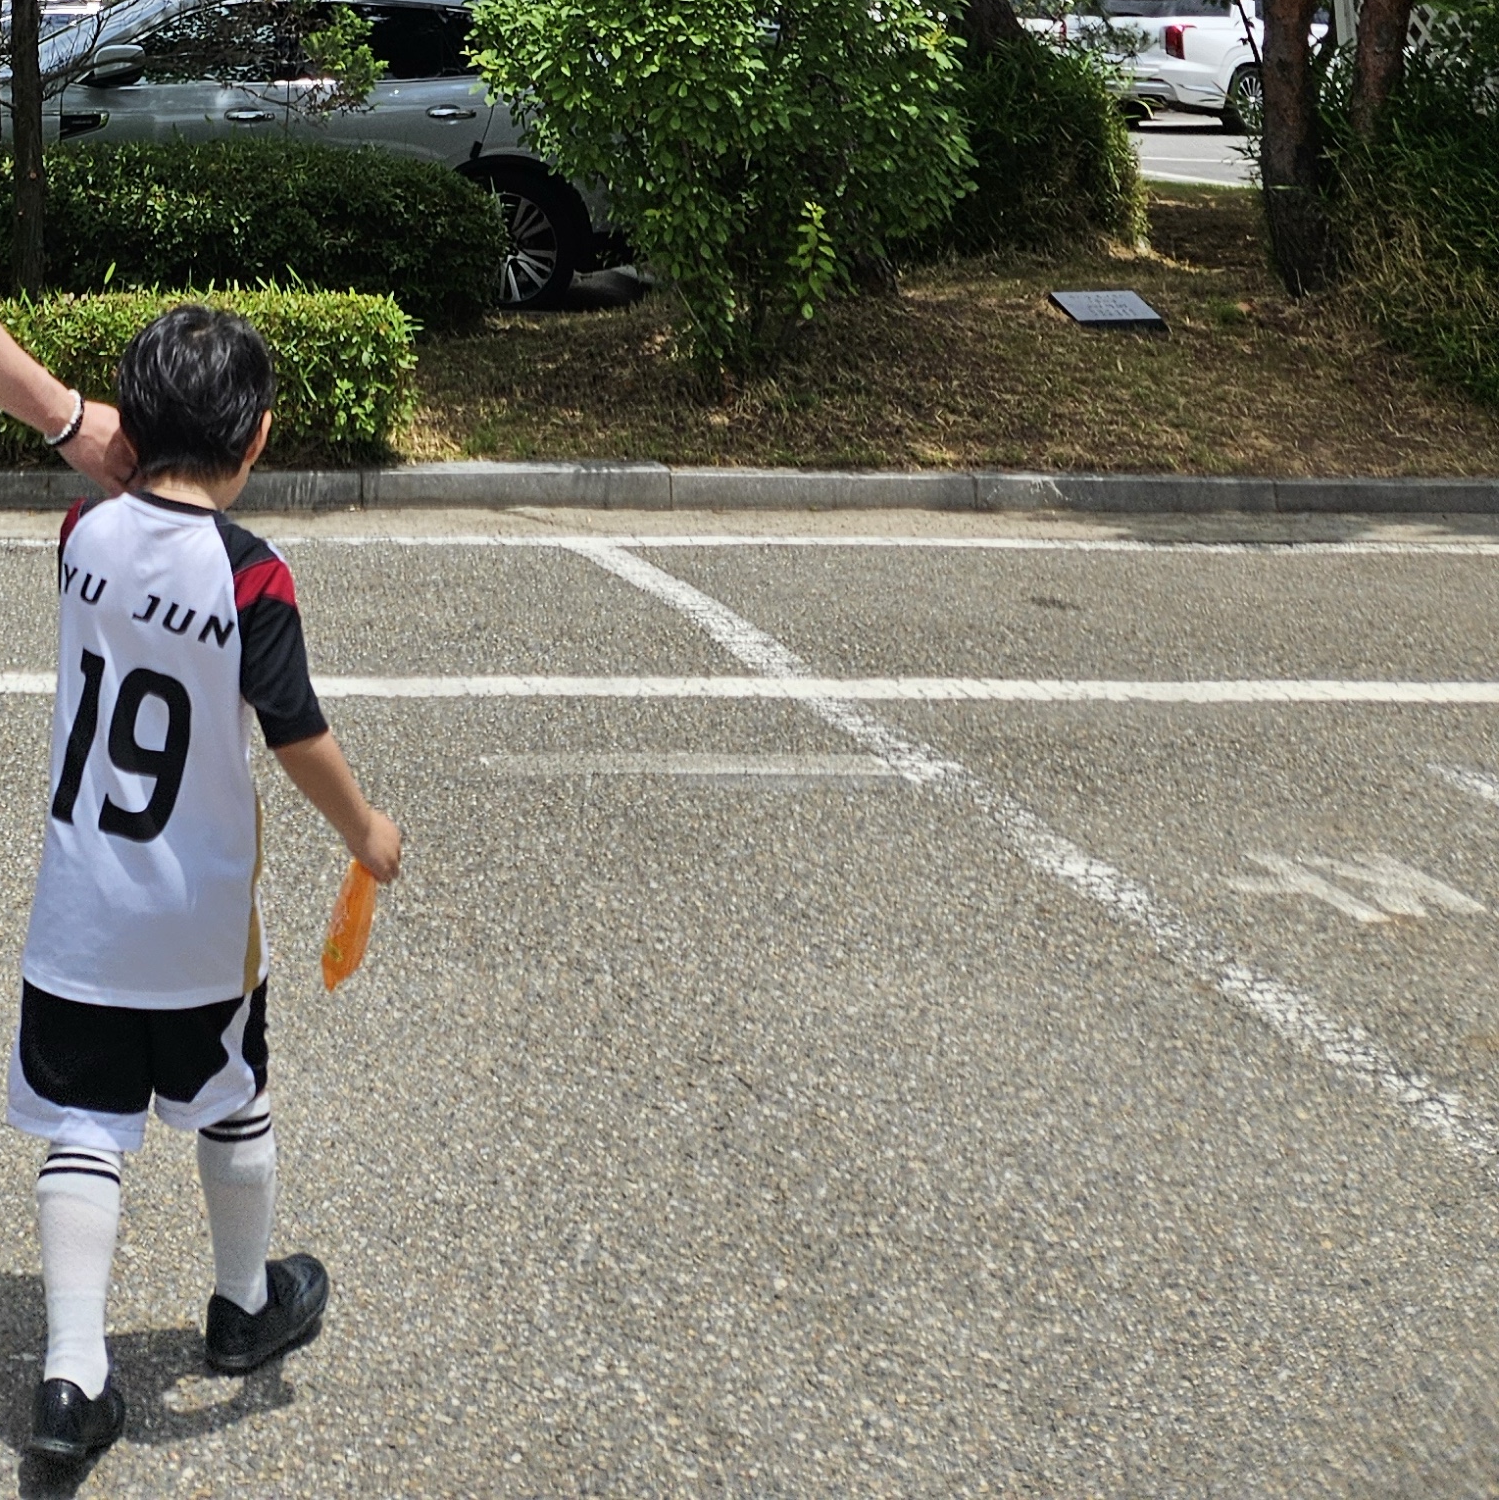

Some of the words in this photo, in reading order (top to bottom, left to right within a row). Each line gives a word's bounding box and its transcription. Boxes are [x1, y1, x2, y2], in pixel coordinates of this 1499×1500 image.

[63, 563, 107, 605] YU
[132, 594, 235, 649] JUN
[51, 647, 192, 843] 19
